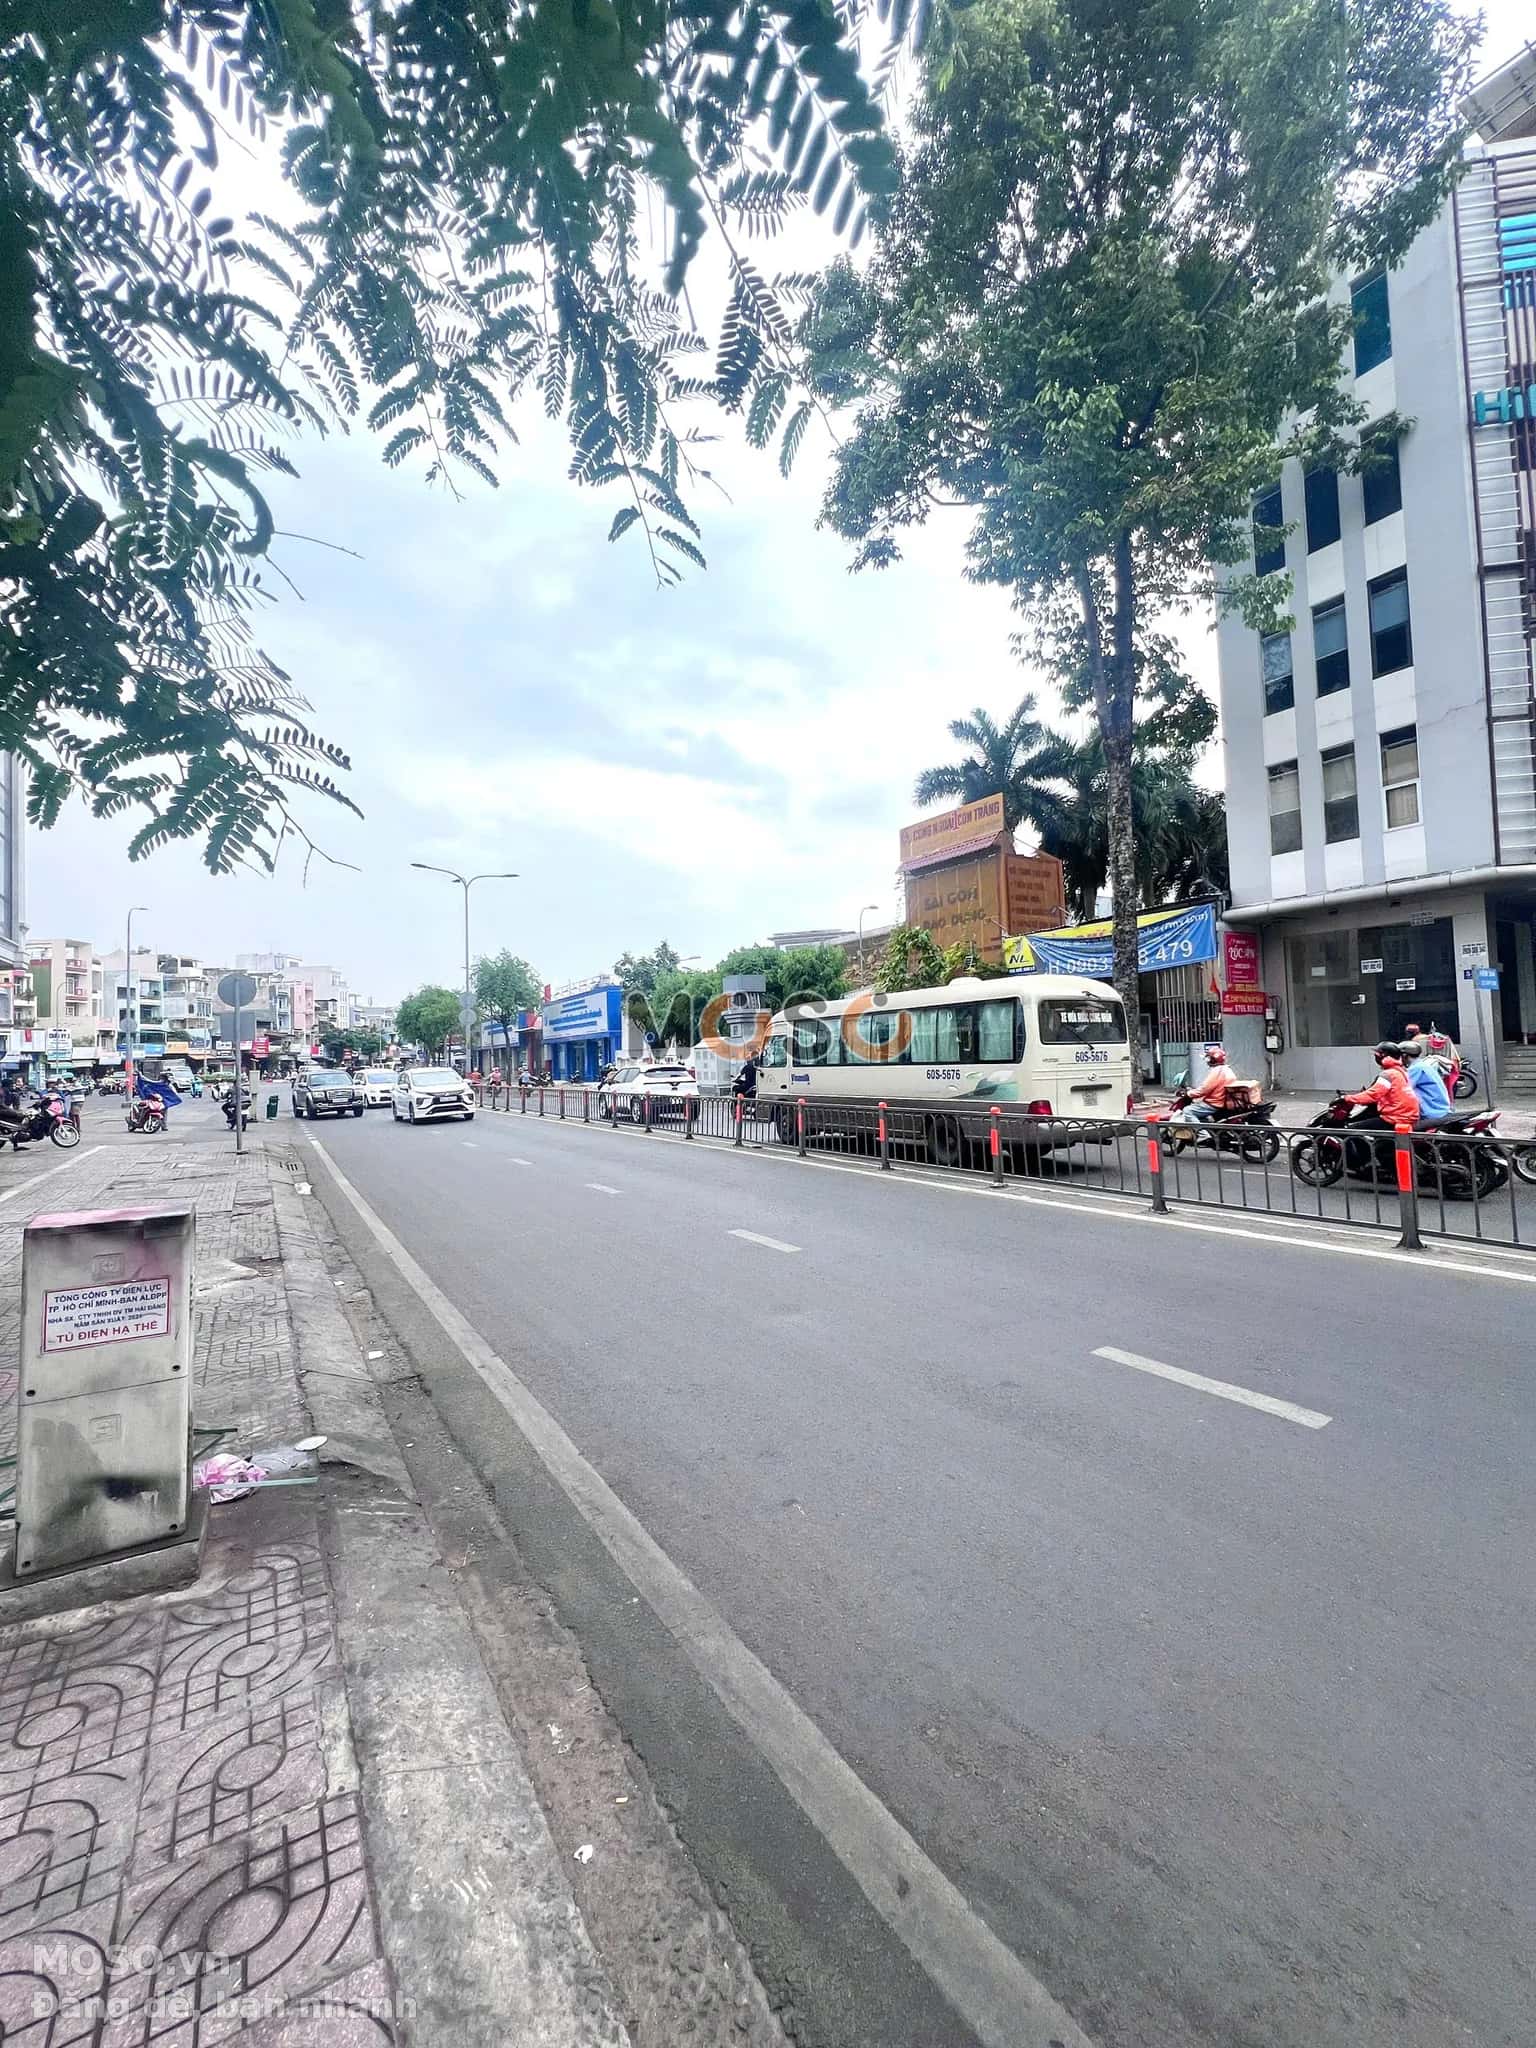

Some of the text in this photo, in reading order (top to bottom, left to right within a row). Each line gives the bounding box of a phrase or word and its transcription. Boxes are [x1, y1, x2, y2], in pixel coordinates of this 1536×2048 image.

[1075, 1051, 1108, 1063] 60S-5676
[926, 1069, 961, 1080] 60S-5676
[82, 1289, 108, 1300] CÔNG
[110, 1288, 121, 1297] TY
[78, 1300, 93, 1309] CHÍ
[56, 1320, 158, 1343] TỦ ĐIỆN HẠ THẾ
